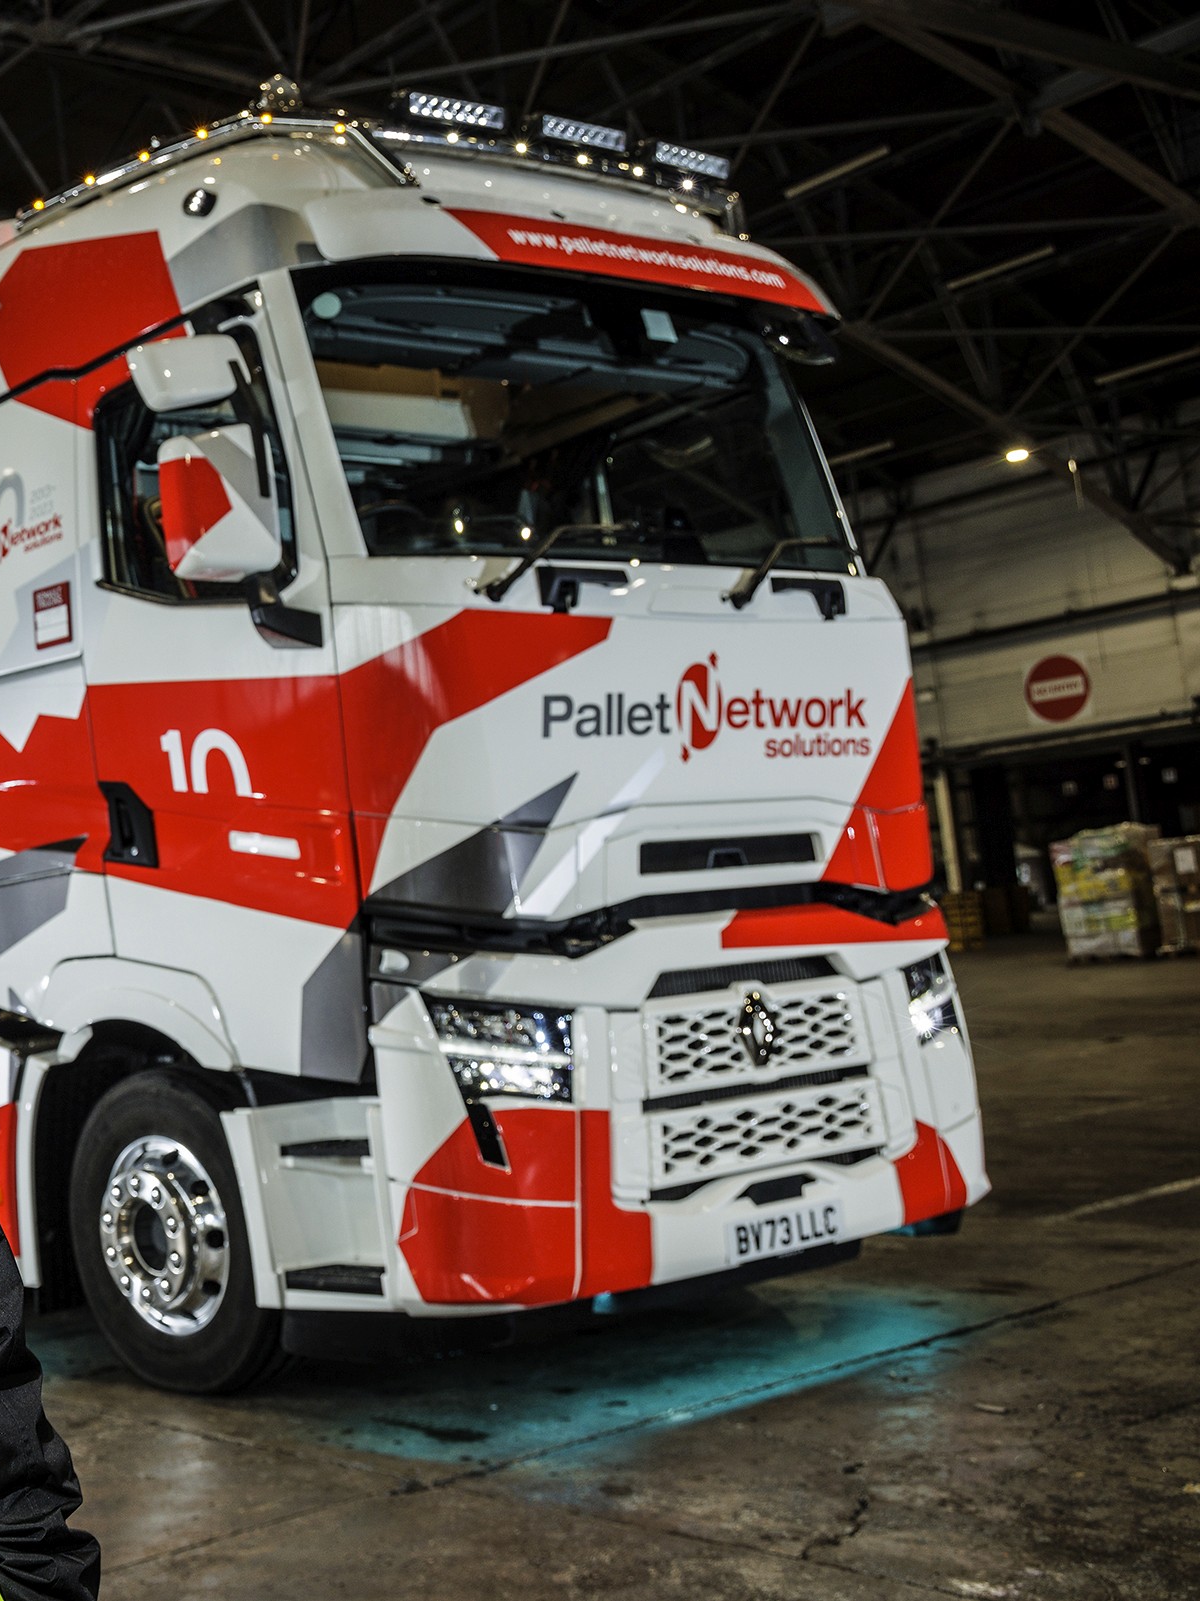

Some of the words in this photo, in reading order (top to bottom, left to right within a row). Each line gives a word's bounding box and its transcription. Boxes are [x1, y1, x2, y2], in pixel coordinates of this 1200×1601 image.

[507, 228, 787, 289] www.palletnetworksolutions.com
[764, 732, 872, 759] solutions
[735, 1216, 793, 1255] BV73
[795, 1206, 837, 1241] LLC
